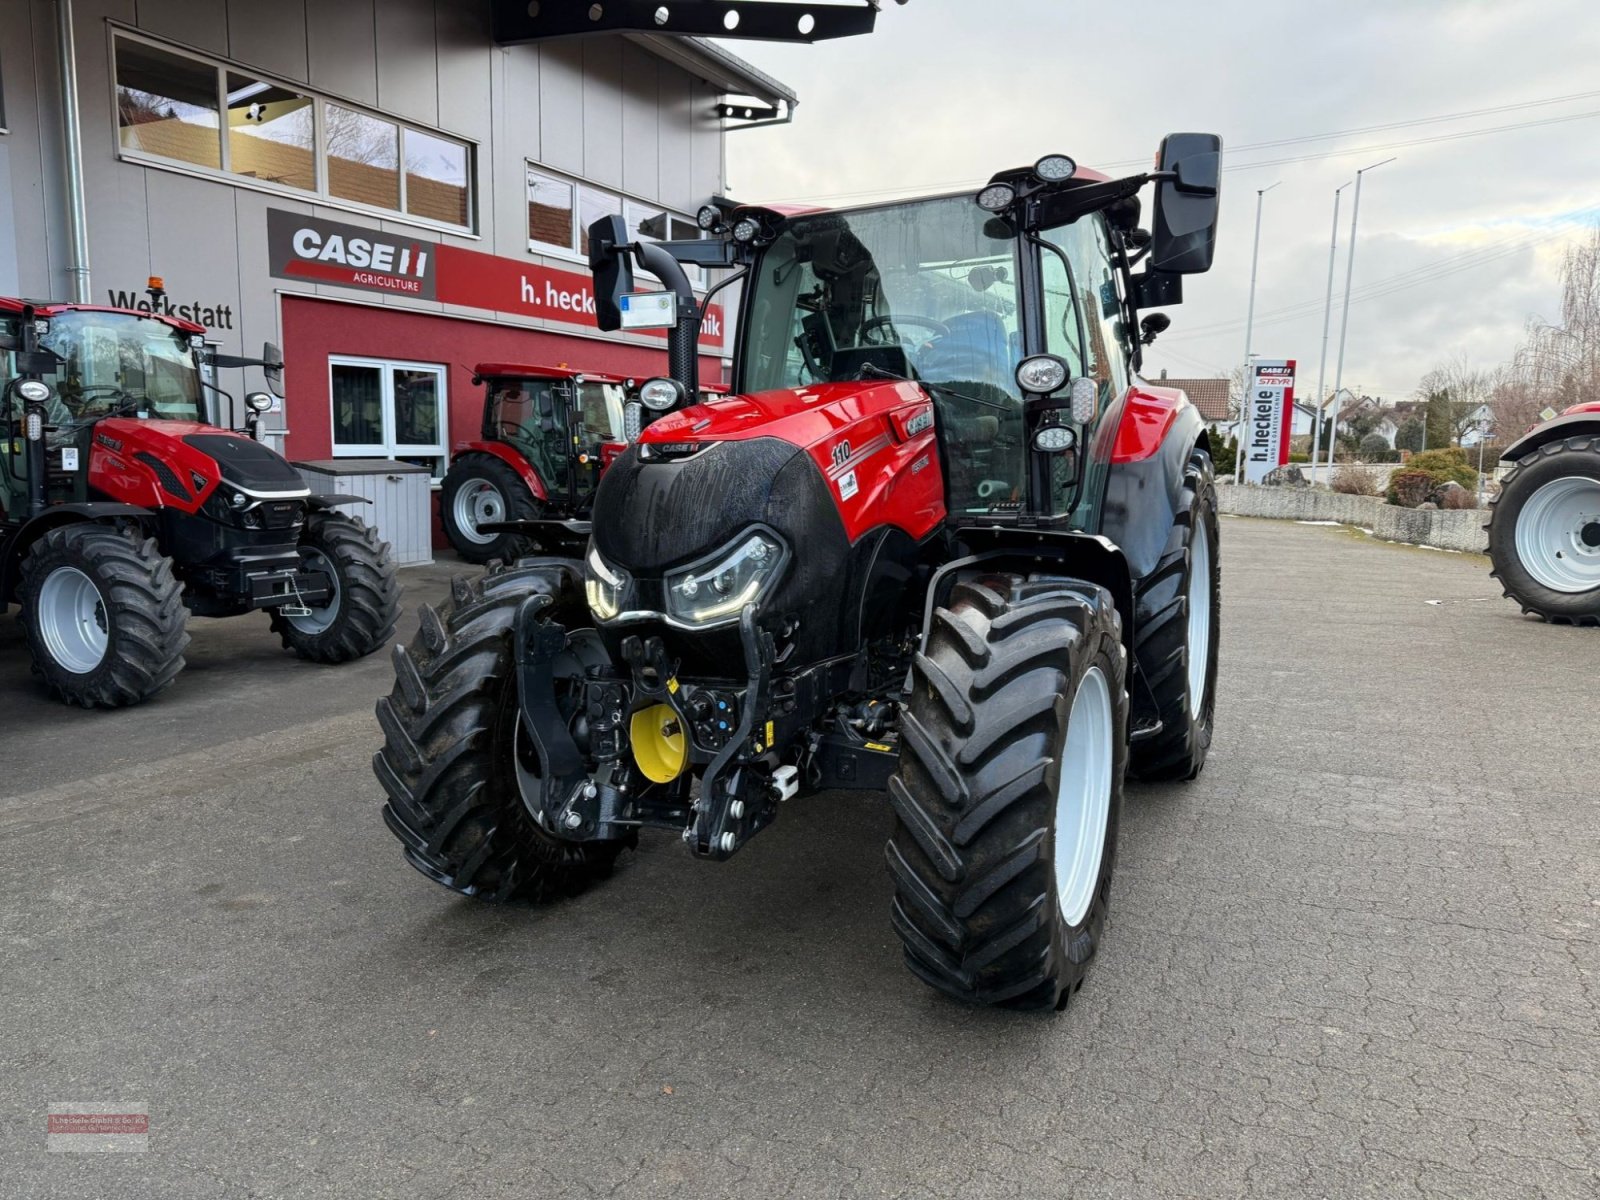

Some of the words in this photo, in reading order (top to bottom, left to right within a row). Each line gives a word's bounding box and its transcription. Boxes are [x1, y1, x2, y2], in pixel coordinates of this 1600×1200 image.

[293, 228, 395, 272] CASE
[353, 272, 419, 292] AGRICULTURE
[545, 280, 597, 315] heck
[662, 444, 689, 453] CASE
[832, 440, 851, 467] 110
